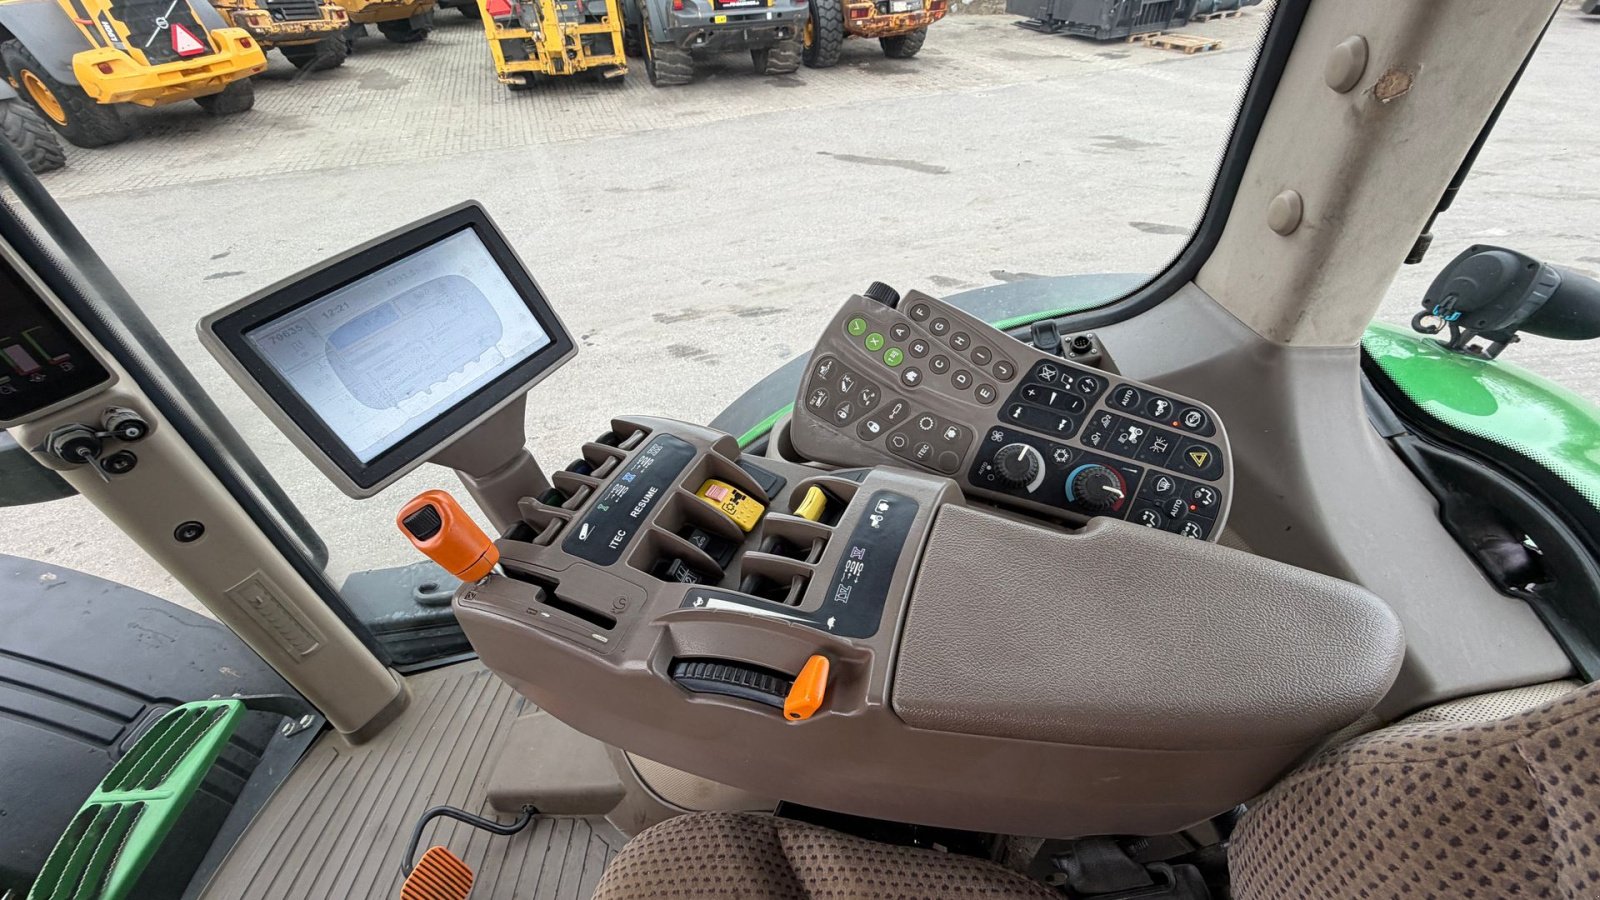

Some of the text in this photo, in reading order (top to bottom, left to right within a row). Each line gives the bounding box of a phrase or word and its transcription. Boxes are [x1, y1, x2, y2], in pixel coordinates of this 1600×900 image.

[322, 302, 350, 319] 12:21
[916, 308, 925, 316] F
[935, 323, 944, 331] G
[896, 329, 905, 337] A
[955, 337, 965, 345] H
[914, 344, 924, 353] B
[935, 359, 944, 368] C
[999, 366, 1007, 375] J
[957, 374, 966, 384] D
[980, 389, 990, 398] E
[1122, 389, 1133, 406] AUTO
[917, 444, 929, 458] ITEC
[979, 462, 988, 475] AUTO
[630, 486, 658, 518] RESUME
[1170, 499, 1182, 517] AUTO
[609, 530, 626, 549] ITEC
